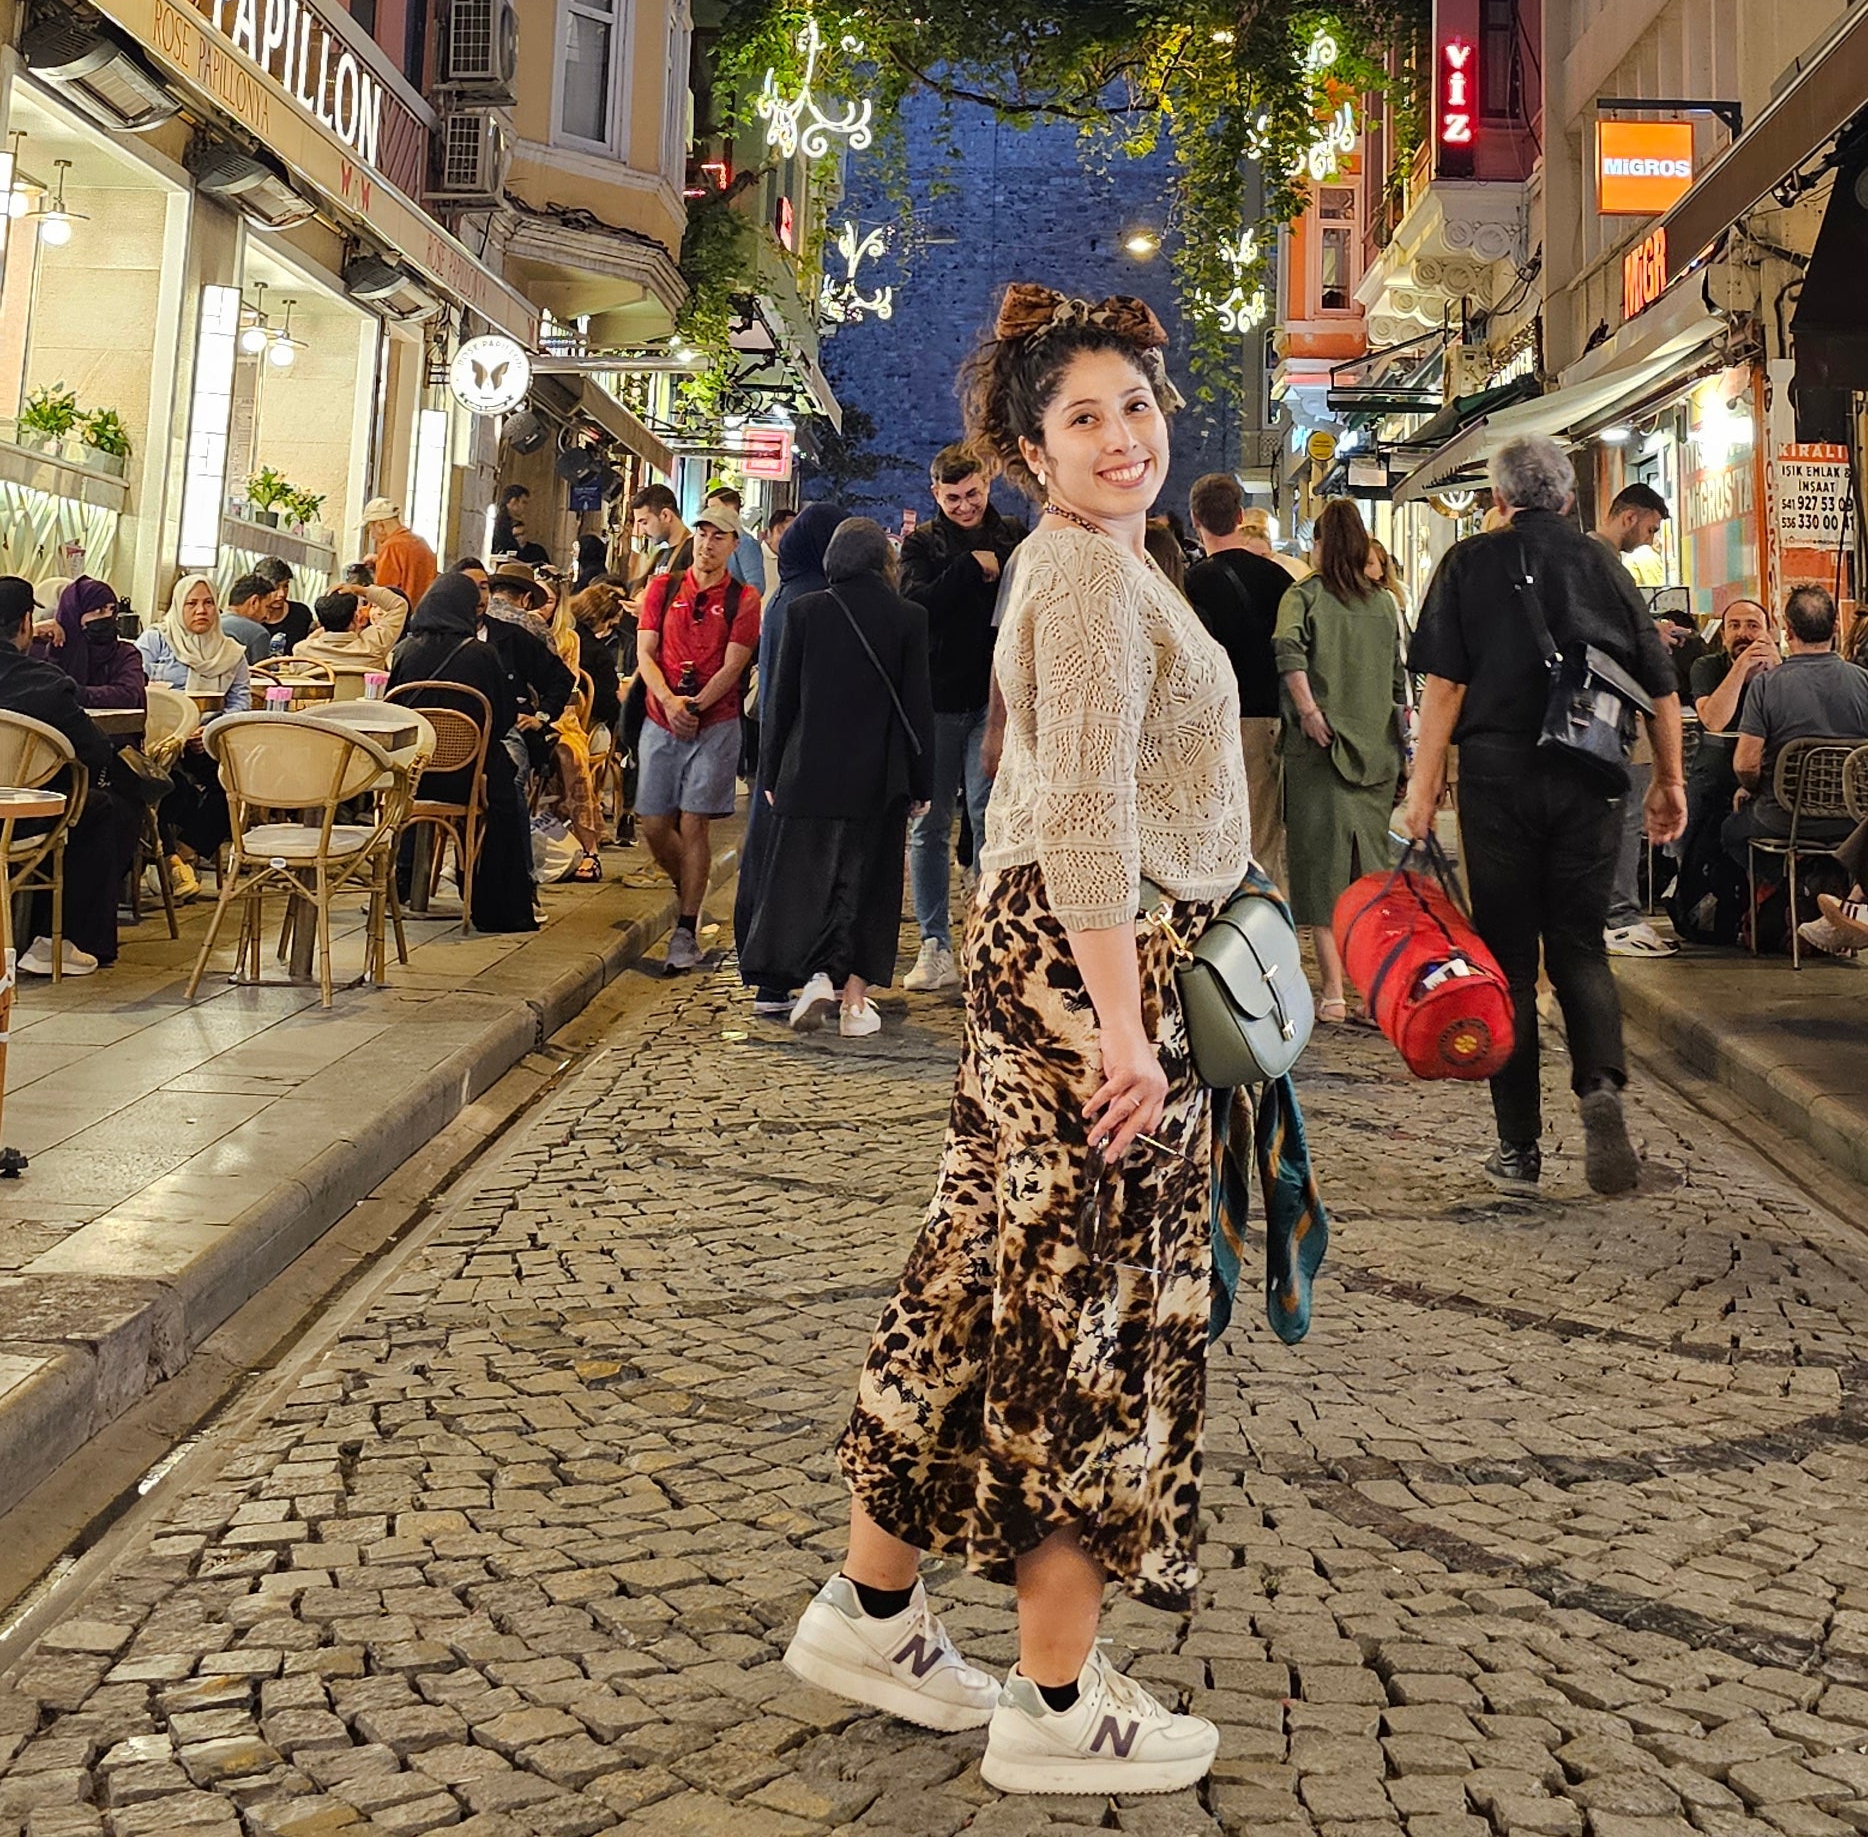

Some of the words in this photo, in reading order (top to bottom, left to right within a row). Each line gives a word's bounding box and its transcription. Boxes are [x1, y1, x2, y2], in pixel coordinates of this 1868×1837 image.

[198, 36, 269, 134] PAPILLONYA
[457, 344, 479, 366] ROSE
[1806, 466, 1840, 478] EMLAK
[1797, 495, 1818, 511] 927
[1821, 496, 1835, 511] 53
[1798, 513, 1819, 529] 330
[1823, 514, 1838, 530] 00
[892, 1633, 944, 1679] N
[1089, 1714, 1140, 1758] N
